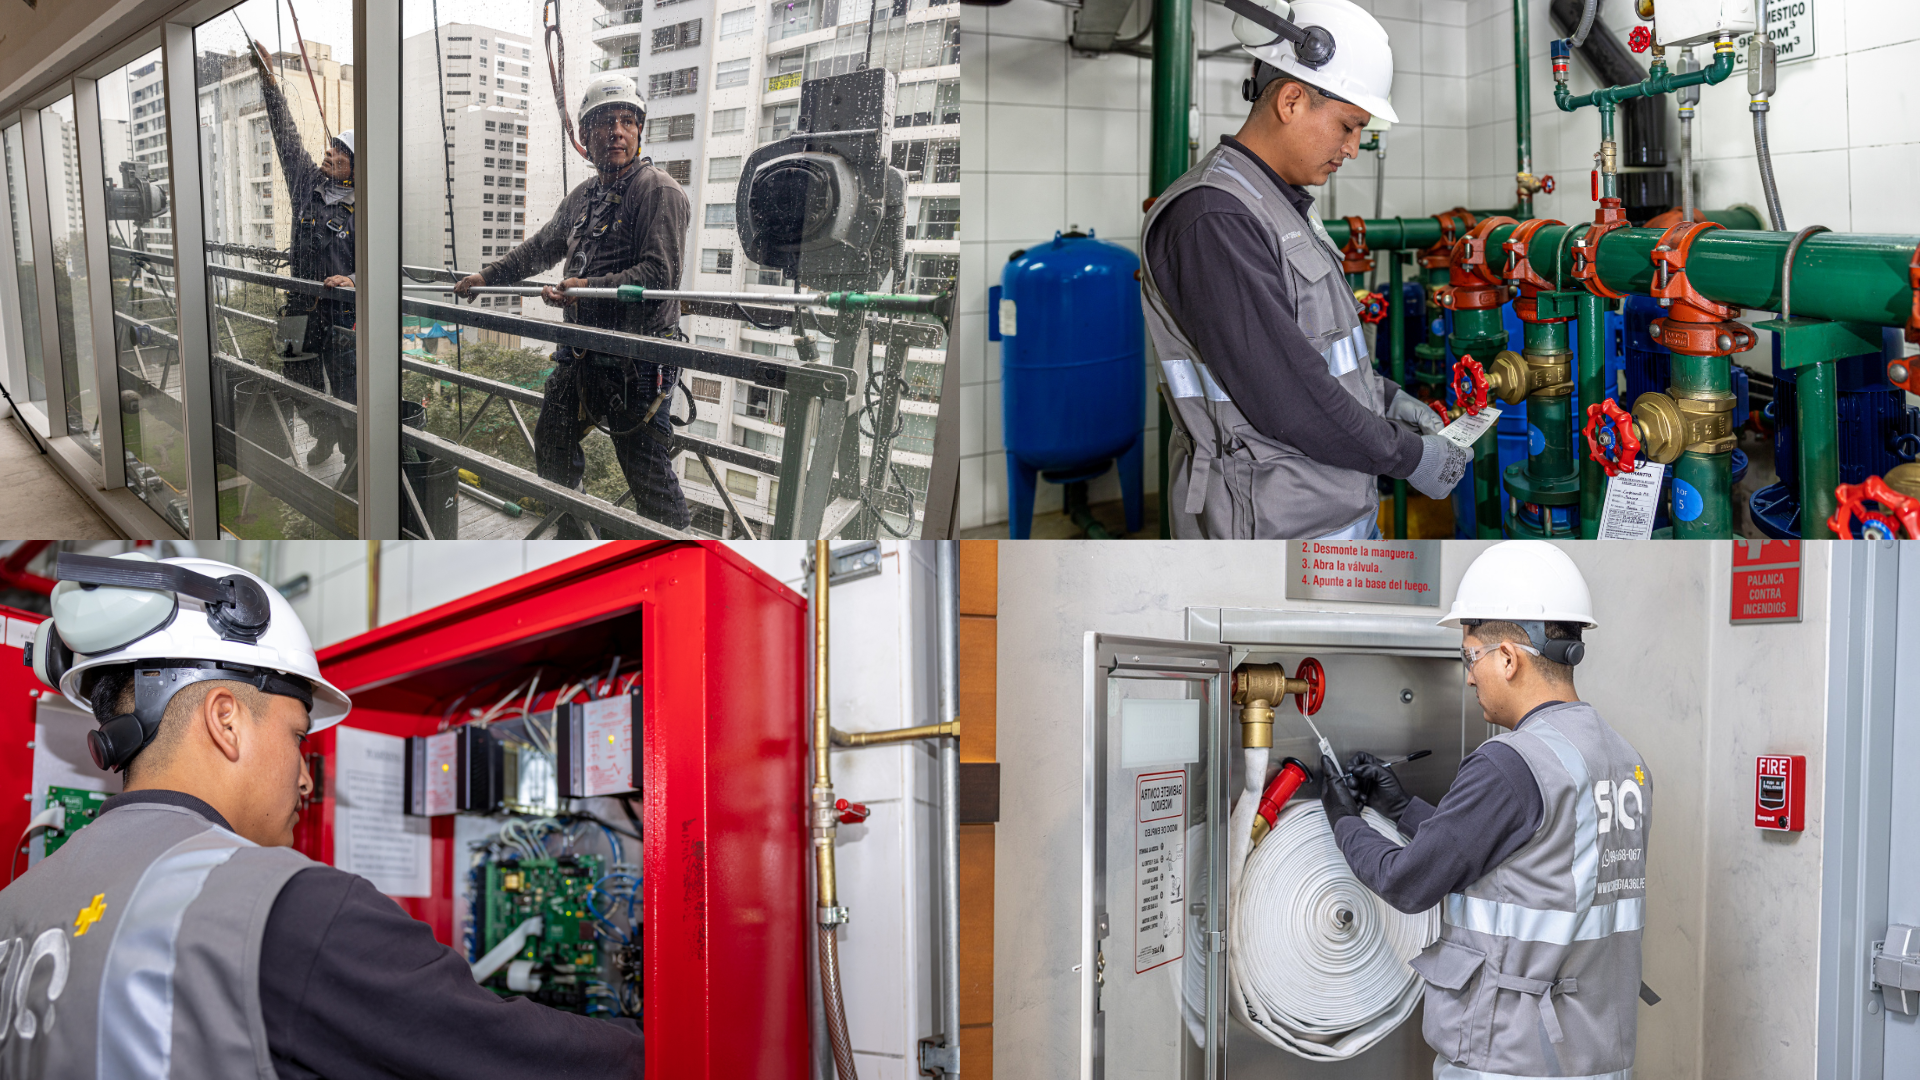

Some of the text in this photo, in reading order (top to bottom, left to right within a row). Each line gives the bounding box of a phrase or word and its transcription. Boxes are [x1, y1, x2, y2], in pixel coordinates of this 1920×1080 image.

[1679, 499, 1685, 510] 5
[1302, 542, 1418, 560] 2. Desmonte la manguera.
[1302, 558, 1383, 573] 3. Abra la válvula.
[1302, 574, 1431, 593] 4. Apunte a la base del fuego.
[1747, 573, 1784, 586] PALANCA
[1749, 588, 1781, 600] CONTRA
[1743, 602, 1786, 615] INCENDIOS
[1759, 759, 1787, 775] FIRE
